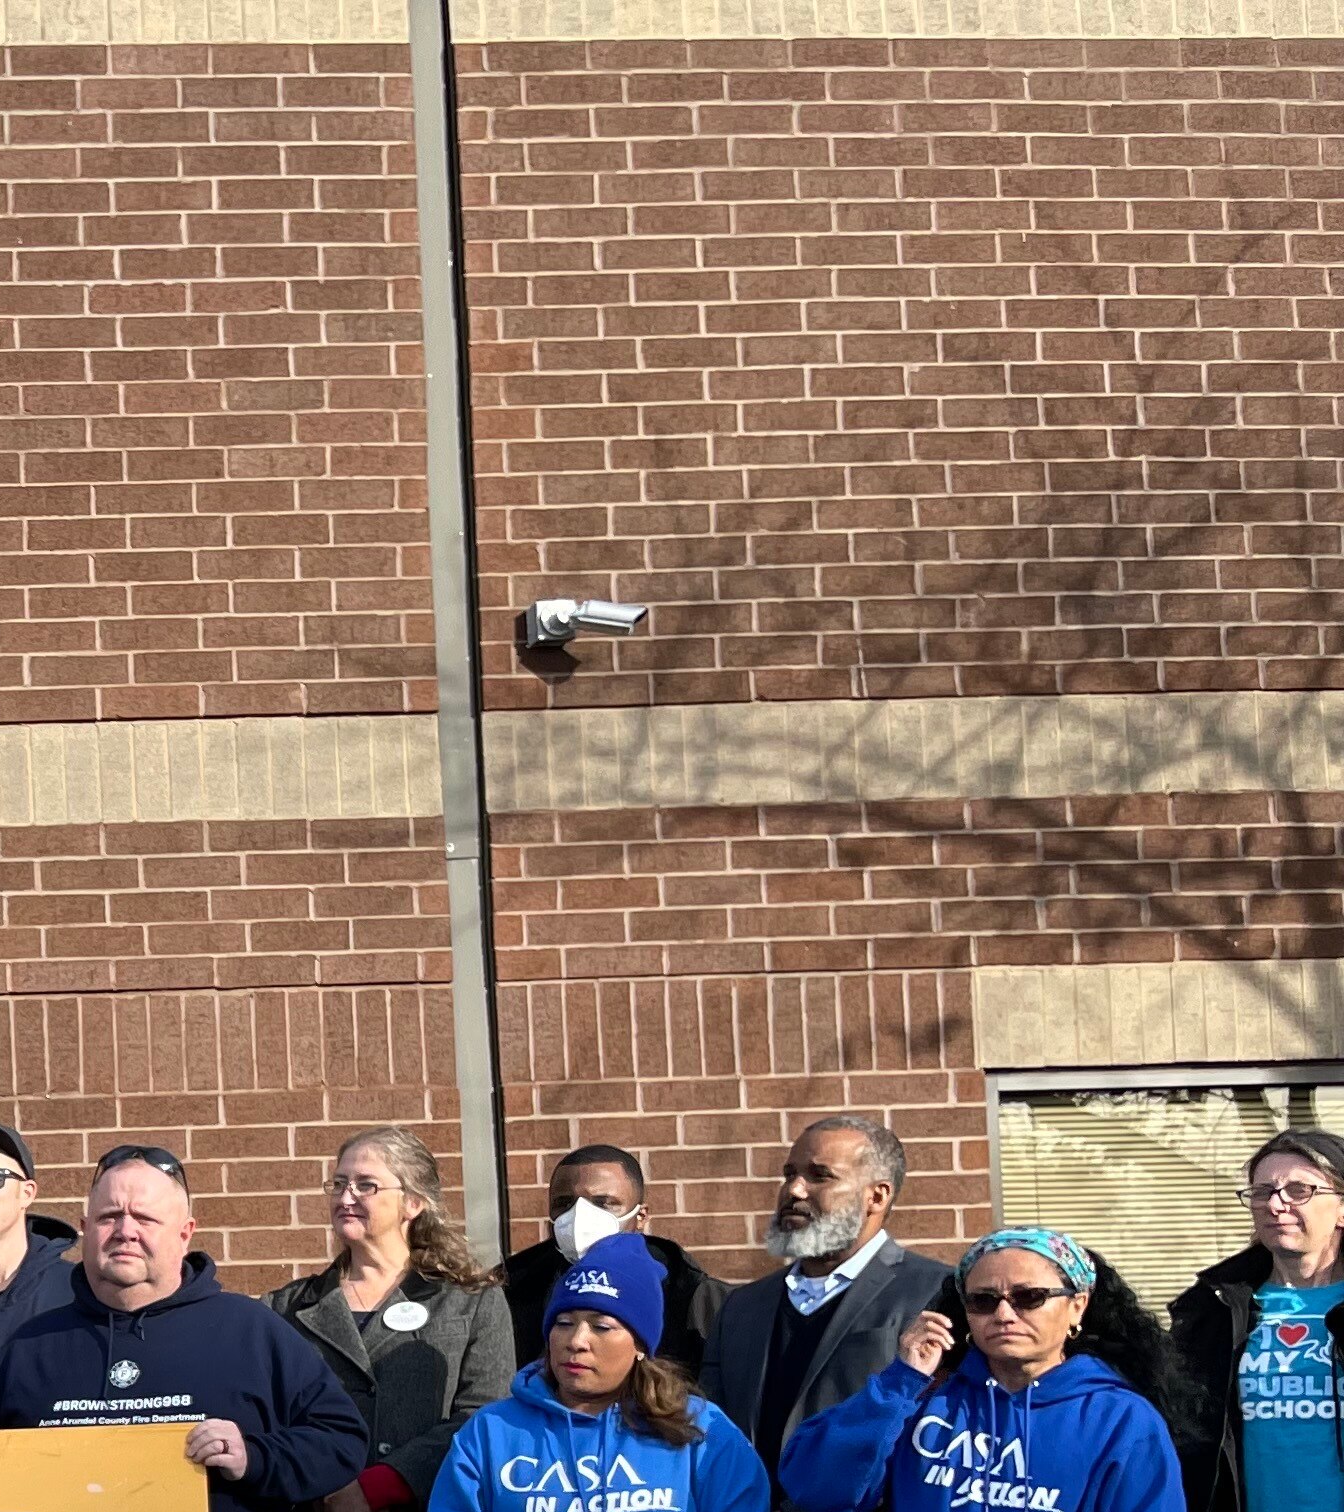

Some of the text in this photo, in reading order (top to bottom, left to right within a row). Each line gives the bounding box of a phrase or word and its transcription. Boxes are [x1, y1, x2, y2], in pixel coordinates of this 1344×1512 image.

[1239, 1351, 1300, 1374] MY
[62, 1416, 97, 1425] Arundel
[98, 1415, 131, 1426] County
[132, 1415, 150, 1424] Fire
[152, 1413, 206, 1423] Department
[912, 1415, 1032, 1479] CASA
[500, 1453, 647, 1493] CASA
[924, 1465, 954, 1488] IN
